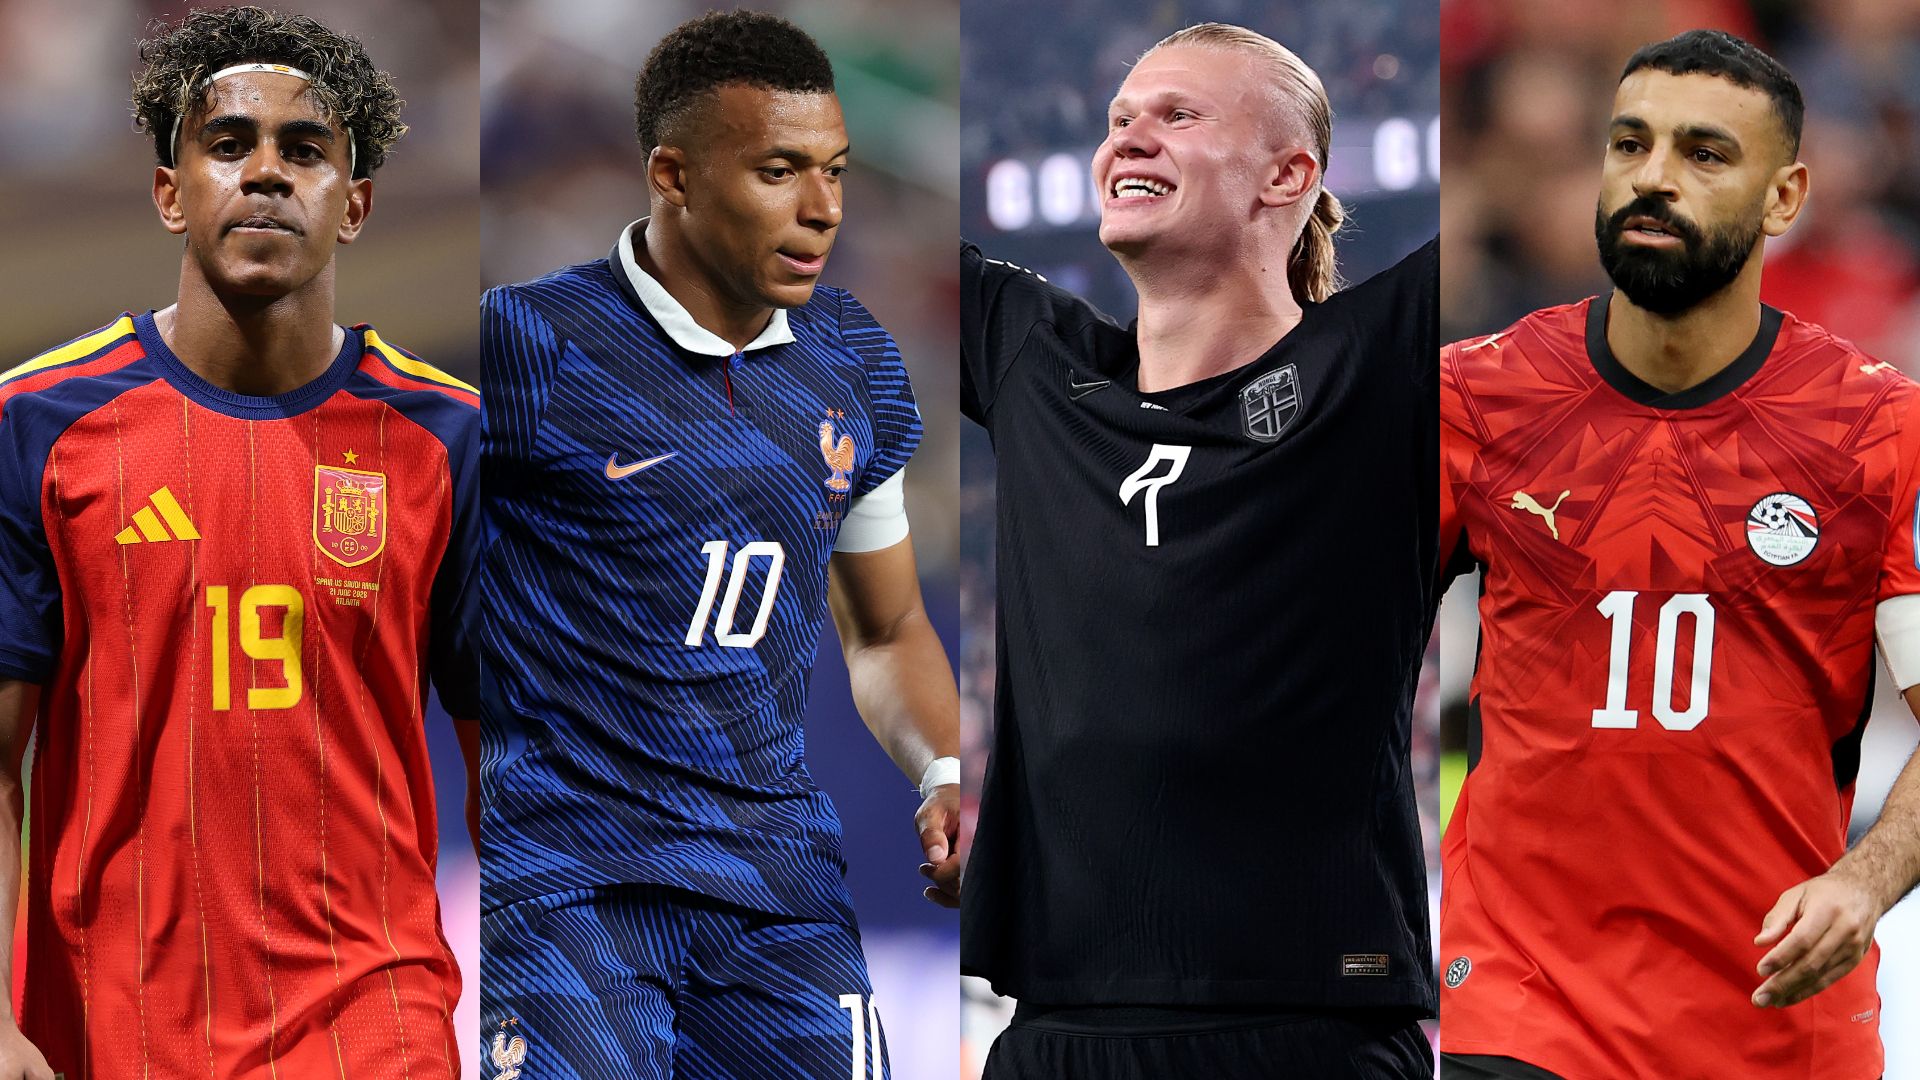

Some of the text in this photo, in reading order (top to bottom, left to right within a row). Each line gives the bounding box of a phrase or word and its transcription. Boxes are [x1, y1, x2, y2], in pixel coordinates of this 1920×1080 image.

[1119, 443, 1192, 546] 9
[206, 584, 304, 711] 19
[335, 597, 360, 607] ATLANTA
[684, 540, 786, 648] 10
[1591, 590, 1716, 731] 10
